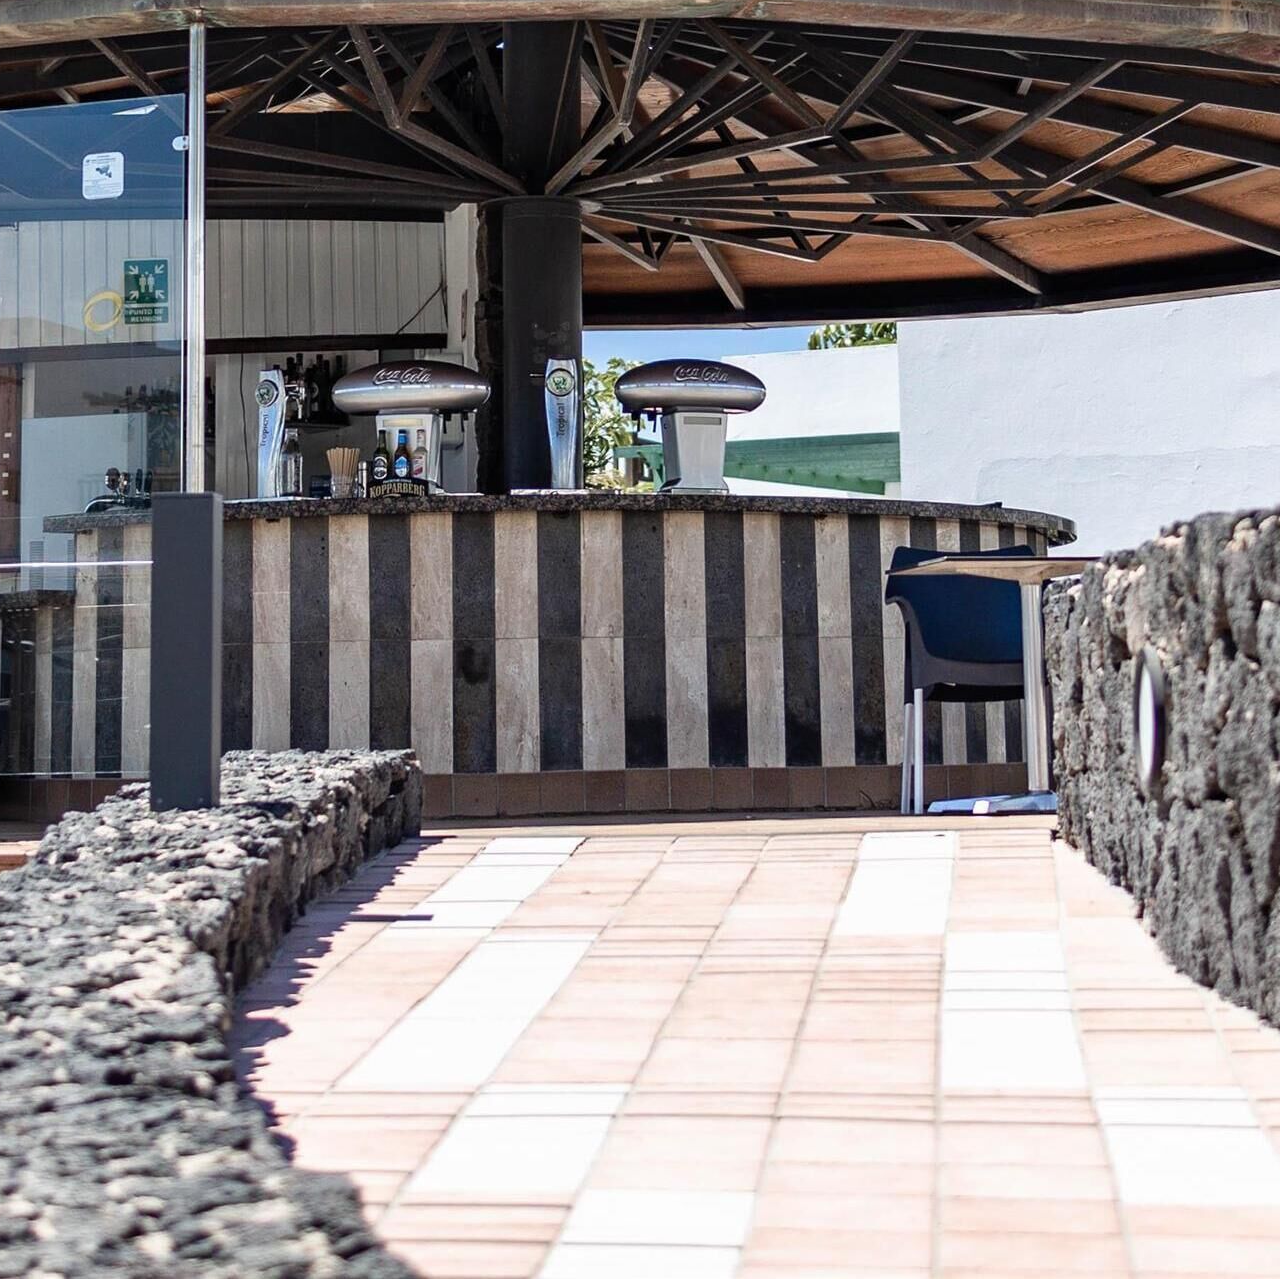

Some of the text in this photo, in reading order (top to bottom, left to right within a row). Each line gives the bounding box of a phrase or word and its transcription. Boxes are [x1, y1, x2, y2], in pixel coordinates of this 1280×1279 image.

[260, 414, 270, 447] Tropical
[556, 402, 566, 437] Tropical
[369, 482, 425, 498] KOPPARBERG
